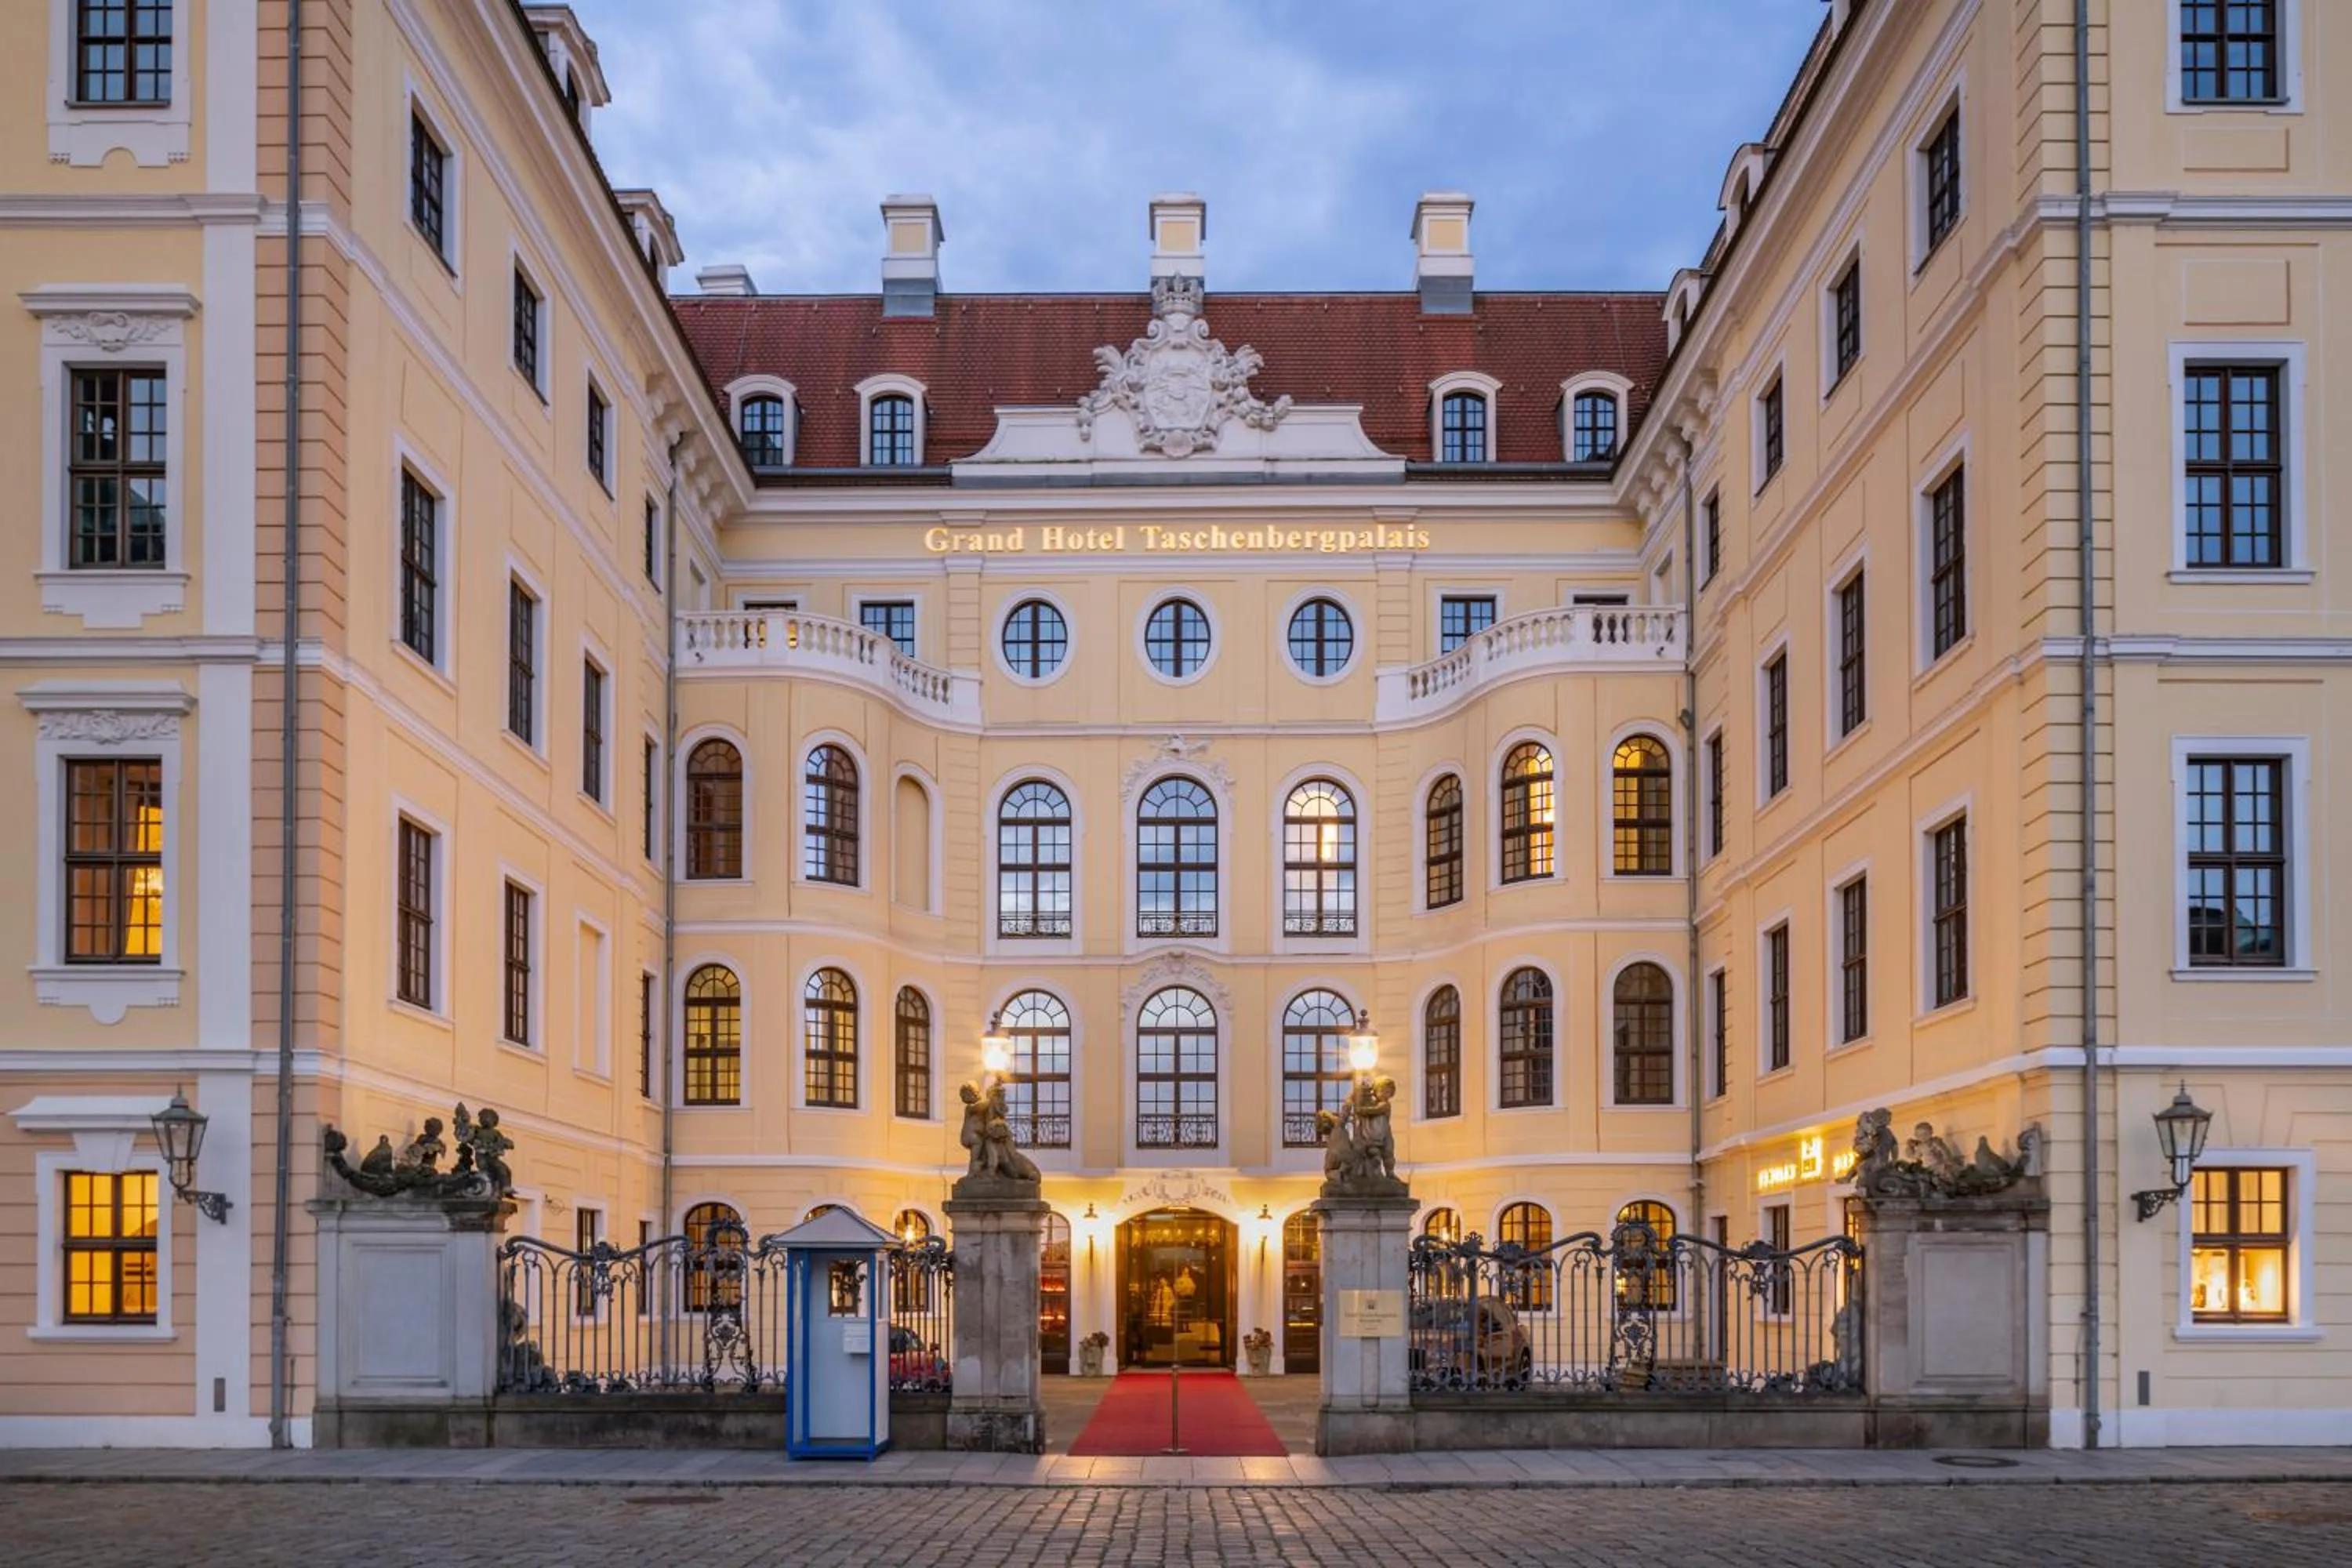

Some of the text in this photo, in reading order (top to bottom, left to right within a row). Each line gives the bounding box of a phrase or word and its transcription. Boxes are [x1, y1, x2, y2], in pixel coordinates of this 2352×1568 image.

[924, 524, 1430, 552] Grand Hotel Taschenbergpalais
